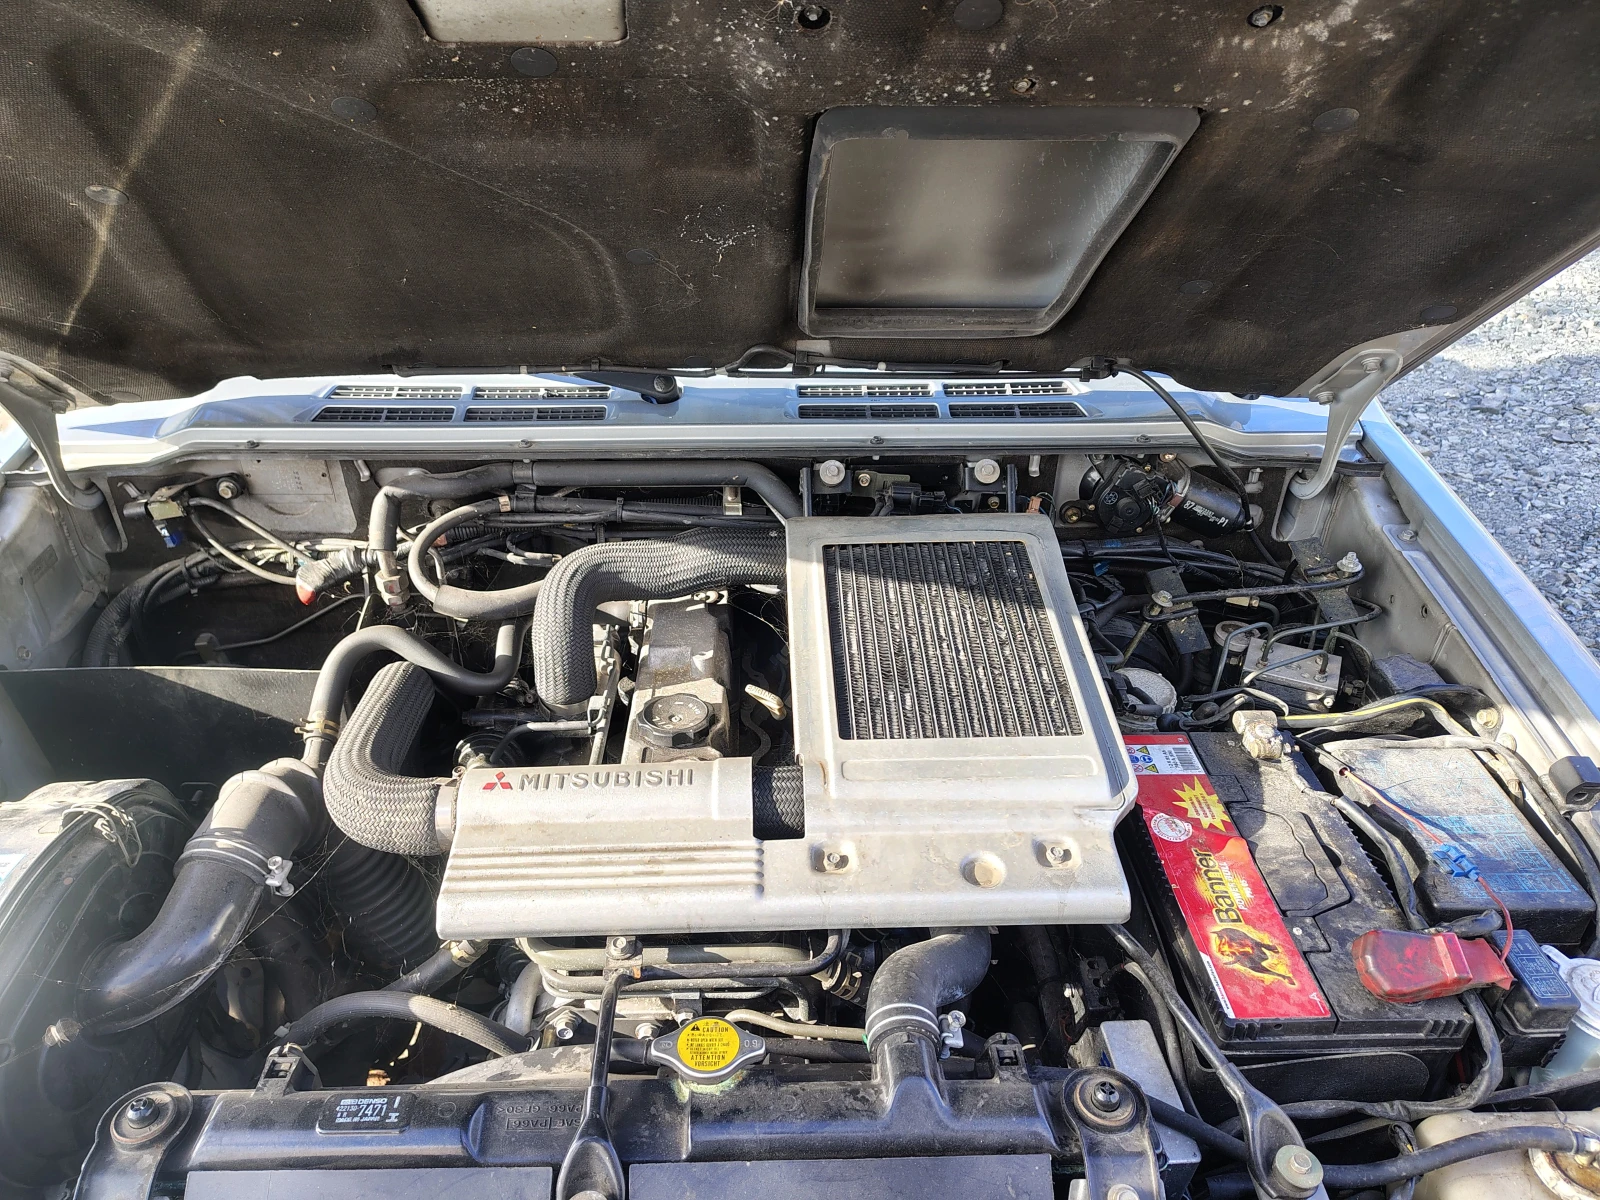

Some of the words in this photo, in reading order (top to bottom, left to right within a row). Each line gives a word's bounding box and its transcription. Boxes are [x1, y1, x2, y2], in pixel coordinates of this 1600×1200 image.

[518, 768, 694, 791] MITSUBISHI
[1192, 848, 1243, 923] Banner
[1228, 882, 1248, 911] POWER
[744, 1039, 758, 1048] 0.9
